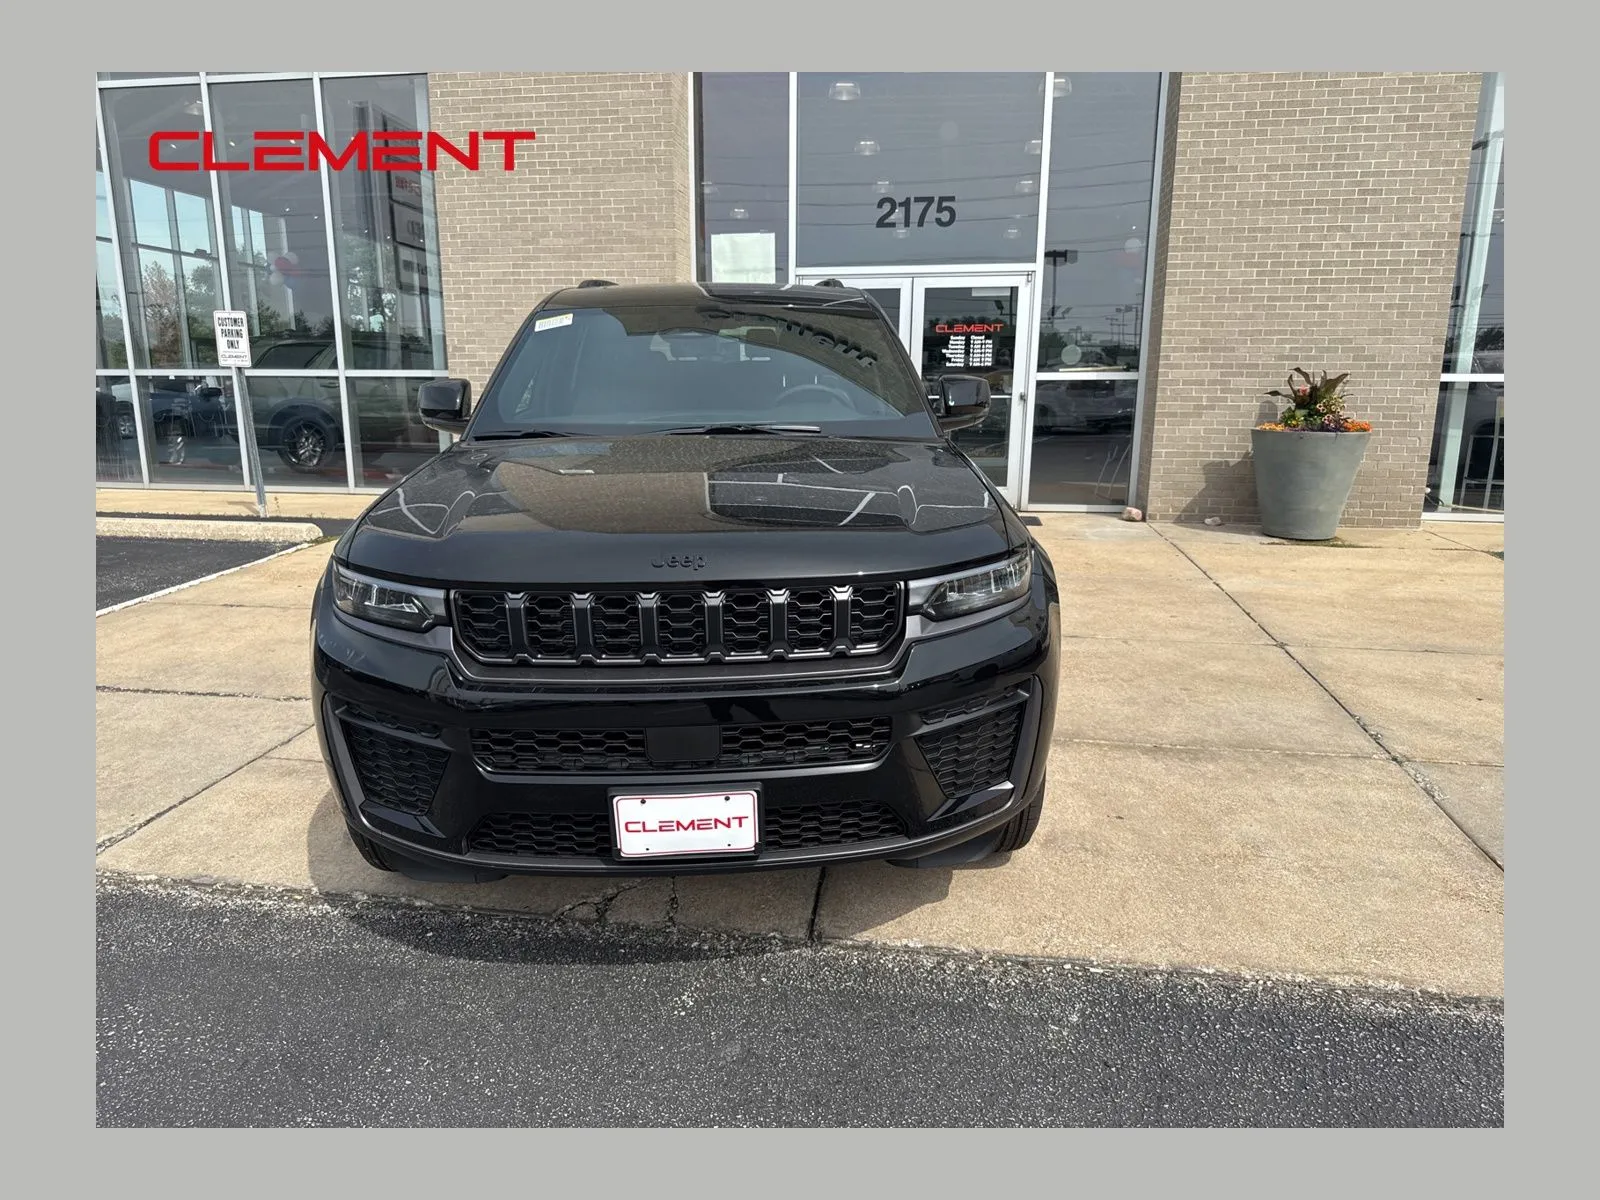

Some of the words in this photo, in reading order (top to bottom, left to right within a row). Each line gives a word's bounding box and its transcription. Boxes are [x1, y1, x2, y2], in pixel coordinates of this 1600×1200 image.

[876, 196, 956, 228] 2175
[217, 317, 244, 327] CUSTOMER
[220, 328, 243, 339] PARKING
[935, 324, 1004, 333] CLEMENT
[226, 340, 239, 349] ONLY
[651, 555, 706, 571] Jeep
[624, 816, 749, 833] CLEMENT
